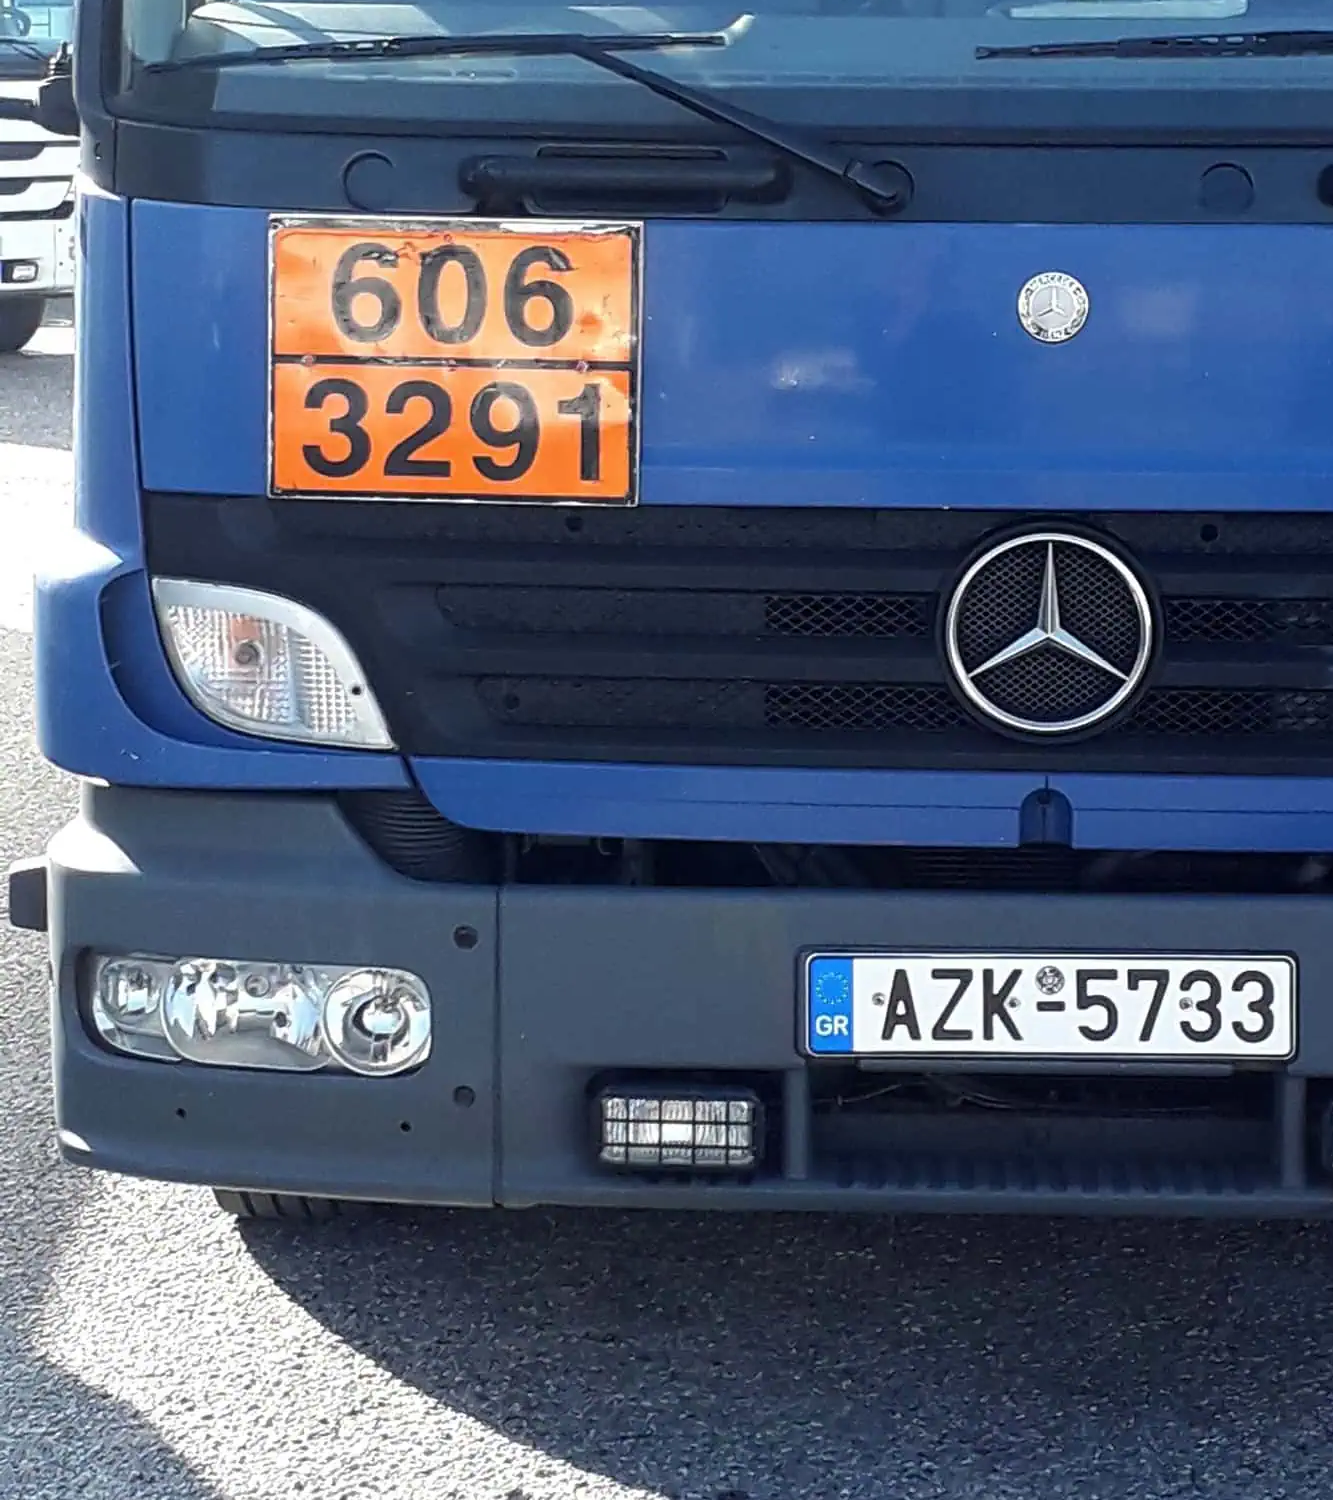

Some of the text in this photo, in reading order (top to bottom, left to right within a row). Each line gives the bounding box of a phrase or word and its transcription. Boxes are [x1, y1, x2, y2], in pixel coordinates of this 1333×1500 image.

[332, 242, 576, 348] 606
[302, 378, 602, 482] 3291
[815, 1015, 849, 1037] GR
[880, 968, 1275, 1043] AZK-5733
